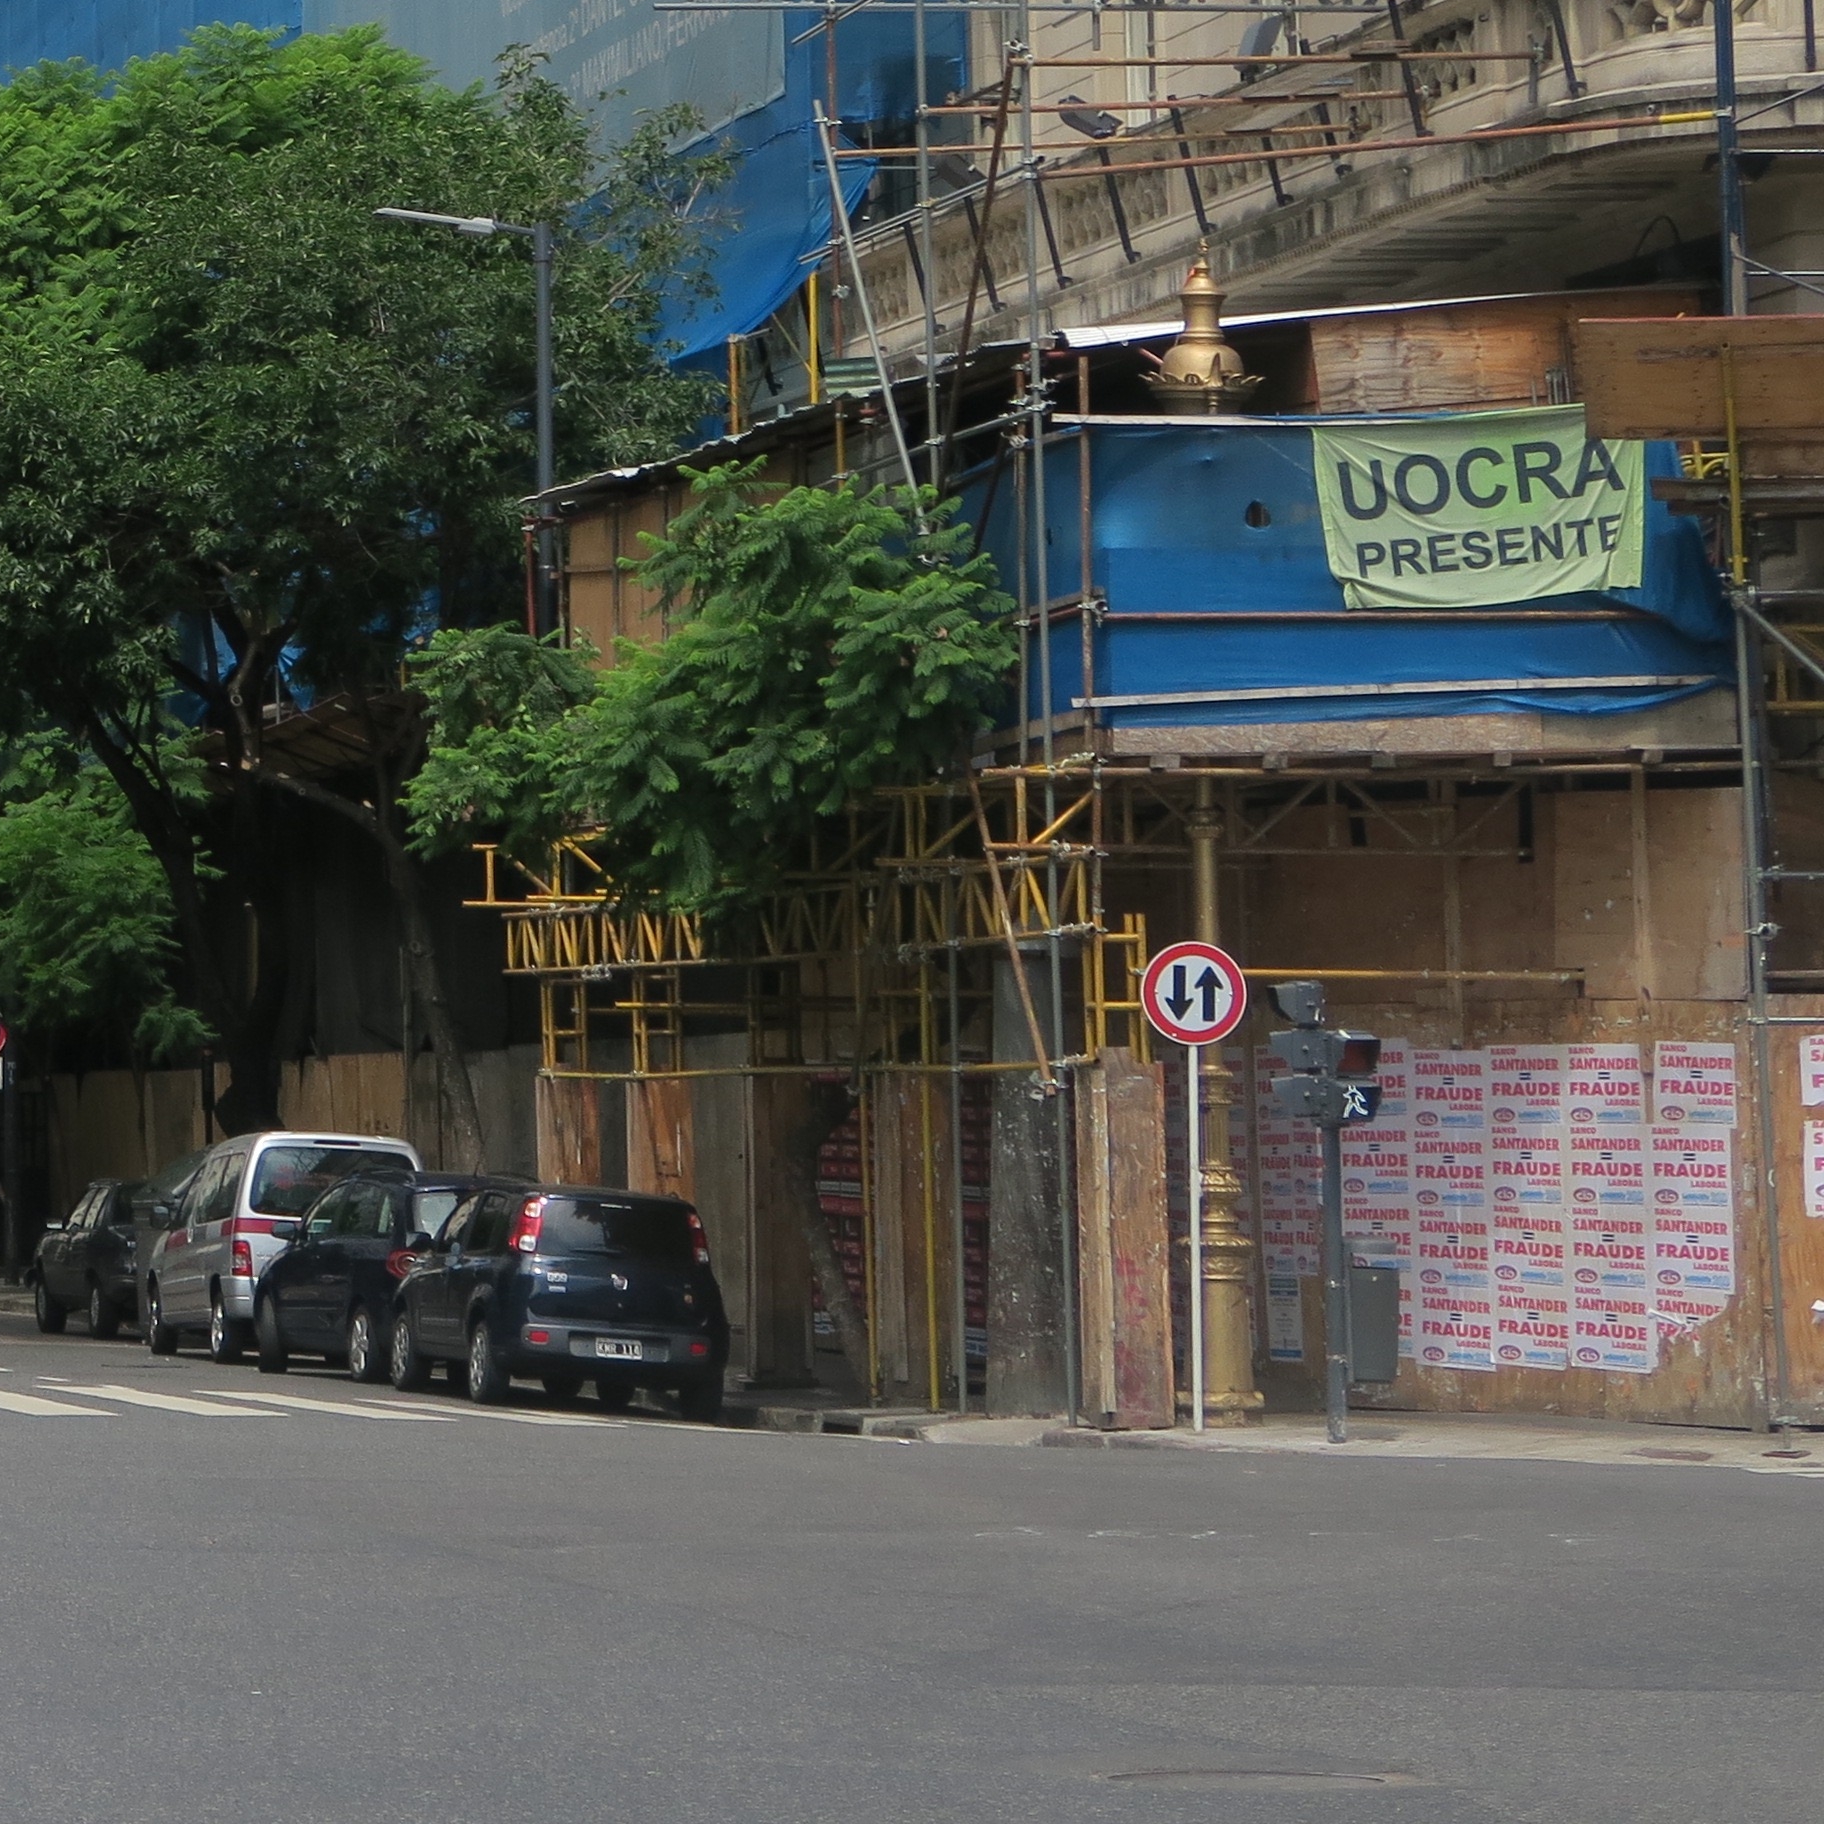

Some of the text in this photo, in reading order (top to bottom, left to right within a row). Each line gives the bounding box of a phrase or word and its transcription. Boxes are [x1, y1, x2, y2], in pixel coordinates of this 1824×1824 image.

[1337, 439, 1625, 520] UOCRA
[1356, 514, 1622, 578] PRESENTE
[1414, 1052, 1440, 1060] BANCO
[1491, 1048, 1517, 1056] BANCO
[1491, 1059, 1559, 1070] SANTANDER
[1569, 1058, 1639, 1069] SANTANDER
[1660, 1056, 1733, 1069] SANTANDER
[1415, 1063, 1482, 1076] SANTANDER
[1416, 1087, 1483, 1100] FRAUDE
[1492, 1083, 1560, 1095] FRAUDE
[1570, 1083, 1640, 1095] FRAUDE
[1661, 1080, 1733, 1095] FRAUDE
[1342, 1130, 1407, 1142] SANTANDER
[1415, 1130, 1440, 1139] BANCO
[1415, 1142, 1482, 1153] SANTANDER
[1492, 1138, 1560, 1150] SANTANDER
[1571, 1139, 1641, 1150] SANTANDER
[1654, 1139, 1724, 1151] SANTANDER
[1343, 1154, 1408, 1167] FRAUDE
[1416, 1166, 1484, 1179] FRAUDE
[1493, 1162, 1561, 1175] FRAUDE
[1572, 1163, 1642, 1176] FRAUDE
[1654, 1163, 1727, 1178] FRAUDE
[1528, 1178, 1561, 1186] LABORAL
[1608, 1179, 1643, 1187] LABORAL
[1344, 1197, 1369, 1205] BANCO
[1344, 1209, 1410, 1220] SANTANDER
[1494, 1206, 1519, 1214] BANCO
[1655, 1208, 1682, 1216] BANCO
[1420, 1221, 1487, 1234] SANTANDER
[1494, 1217, 1562, 1231] SANTANDER
[1573, 1220, 1643, 1233] SANTANDER
[1656, 1220, 1728, 1234] SANTANDER
[1419, 1245, 1488, 1260] FRAUDE
[1495, 1240, 1563, 1257] FRAUDE
[1574, 1243, 1645, 1259] FRAUDE
[1656, 1244, 1729, 1260] FRAUDE
[1454, 1262, 1488, 1270] LABORAL
[1529, 1259, 1563, 1268] LABORAL
[1610, 1261, 1645, 1269] LABORAL
[1694, 1262, 1729, 1271] LABORAL
[1422, 1287, 1448, 1295] BANCO
[1498, 1285, 1524, 1293] BANCO
[1656, 1289, 1683, 1297] BANCO
[1423, 1299, 1491, 1313] SANTANDER
[1499, 1296, 1568, 1312] SANTANDER
[1576, 1299, 1646, 1314] SANTANDER
[1657, 1300, 1723, 1316] SANTANDE
[1423, 1322, 1491, 1338] FRAUDE
[1499, 1320, 1568, 1338] FRAUDE
[1576, 1322, 1647, 1339] FRAUDE
[1456, 1340, 1491, 1349] LABORAL
[1533, 1339, 1568, 1349] LABORAL
[1611, 1341, 1648, 1350] LABORAL
